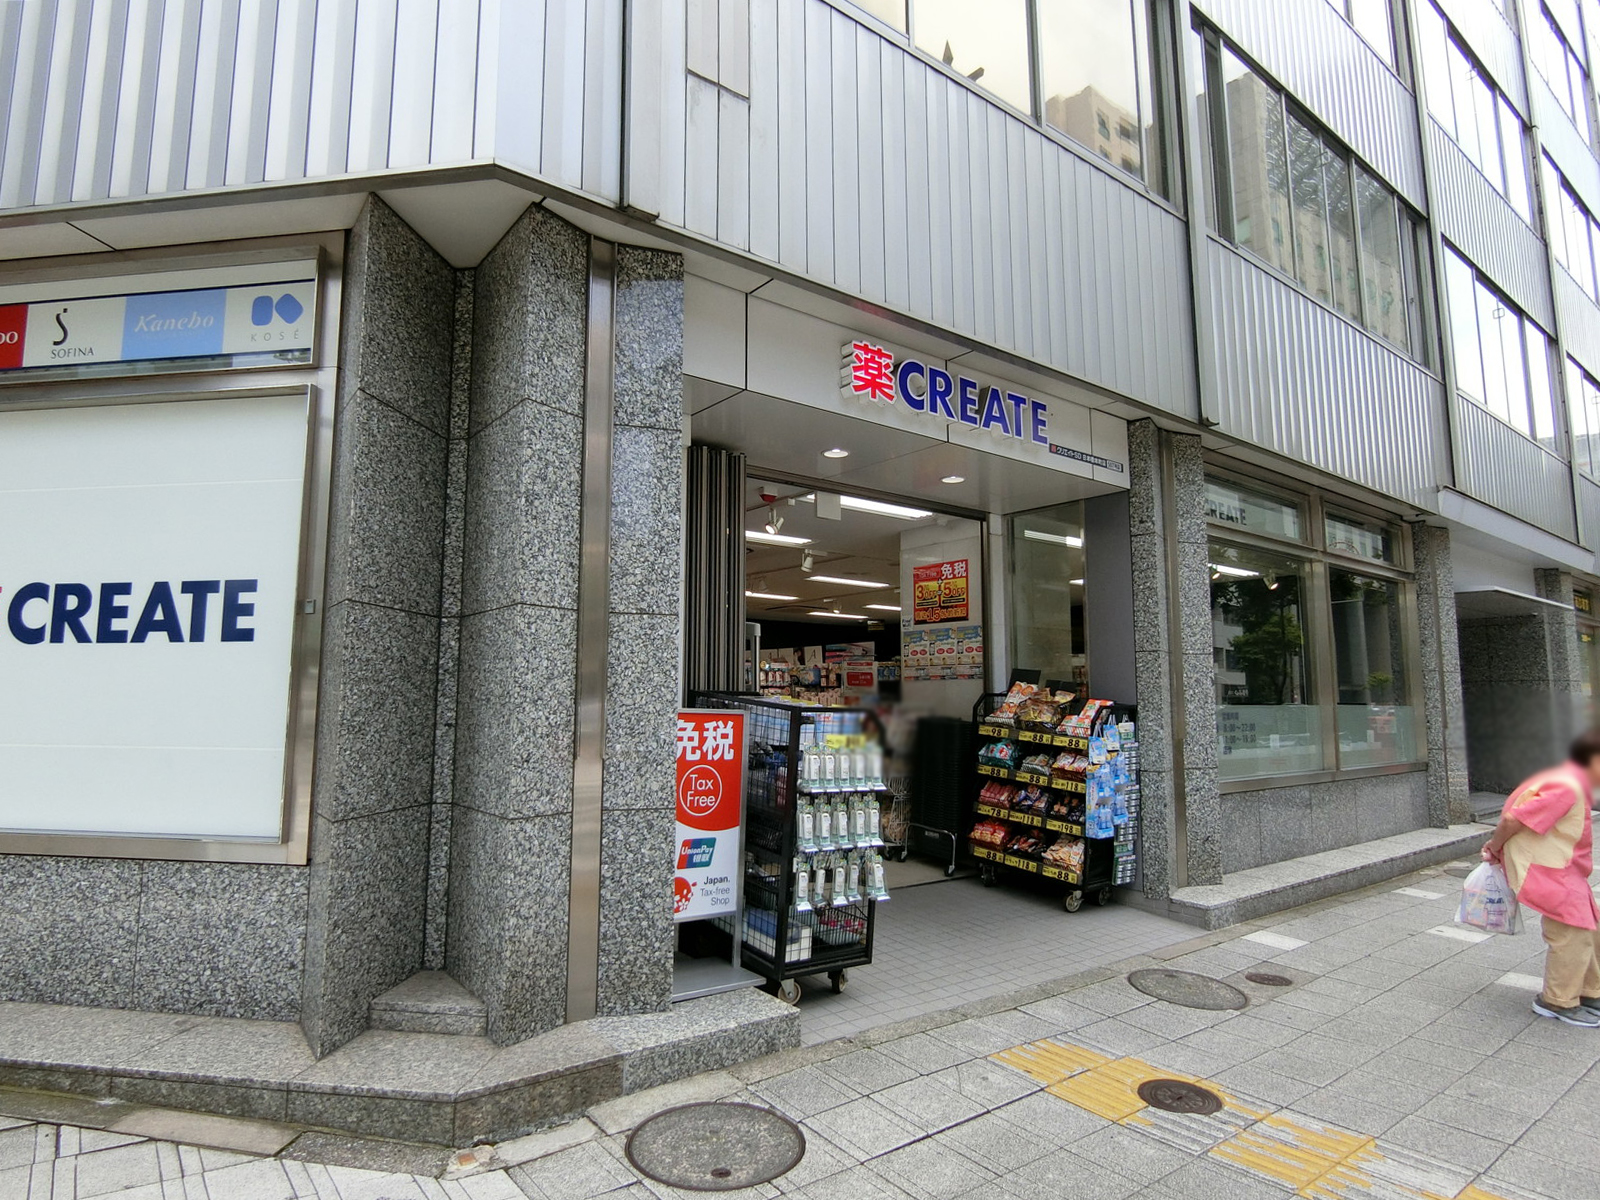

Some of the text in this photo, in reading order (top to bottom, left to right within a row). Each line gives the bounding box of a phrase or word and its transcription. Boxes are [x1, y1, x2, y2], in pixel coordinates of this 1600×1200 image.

[134, 311, 214, 333] Kanebo
[251, 329, 300, 342] KOSÉ
[51, 347, 95, 359] SOFINA
[851, 341, 1049, 445] 薬 CREATE
[941, 561, 967, 579] 免税
[7, 578, 258, 645] CREATE
[676, 719, 735, 761] 免税
[1032, 733, 1044, 743] 88
[1067, 738, 1080, 748] 88
[690, 774, 714, 790] Tax
[1028, 774, 1041, 784] 88
[687, 791, 716, 808] Free
[991, 807, 1002, 817] 78
[681, 845, 714, 857] UnionPay
[703, 875, 731, 886] Japan.
[1057, 870, 1070, 882] 88
[700, 886, 731, 896] Tax-free
[710, 896, 730, 908] Shop
